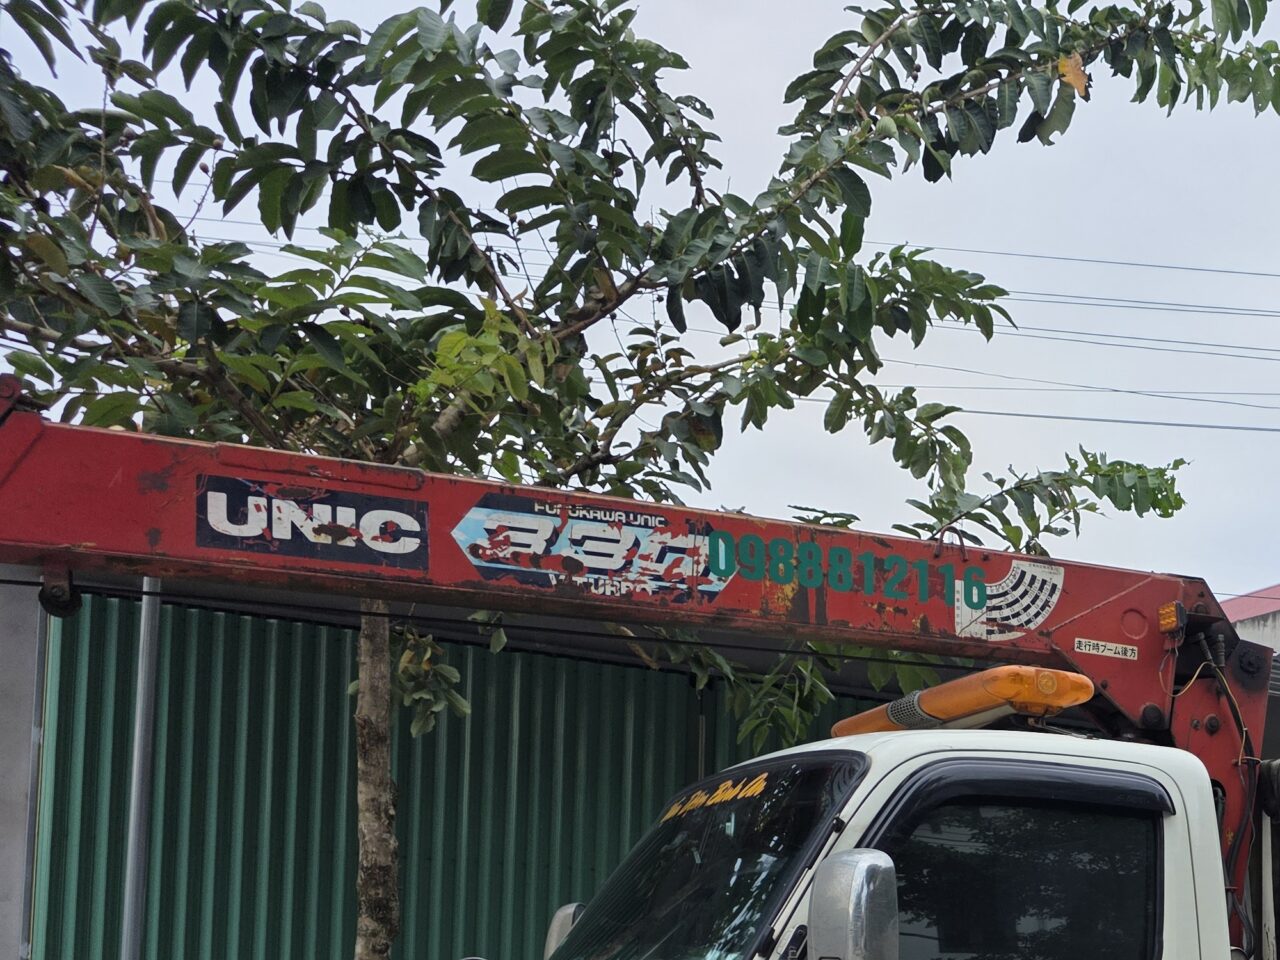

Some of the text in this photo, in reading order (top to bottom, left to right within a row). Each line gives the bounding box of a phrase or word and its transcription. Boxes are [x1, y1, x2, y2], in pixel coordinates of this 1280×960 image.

[207, 491, 422, 554] UNIC
[630, 514, 666, 528] UNIC
[708, 529, 987, 610] 0988812116
[1075, 639, 1137, 659] 走行時ブーム後方
